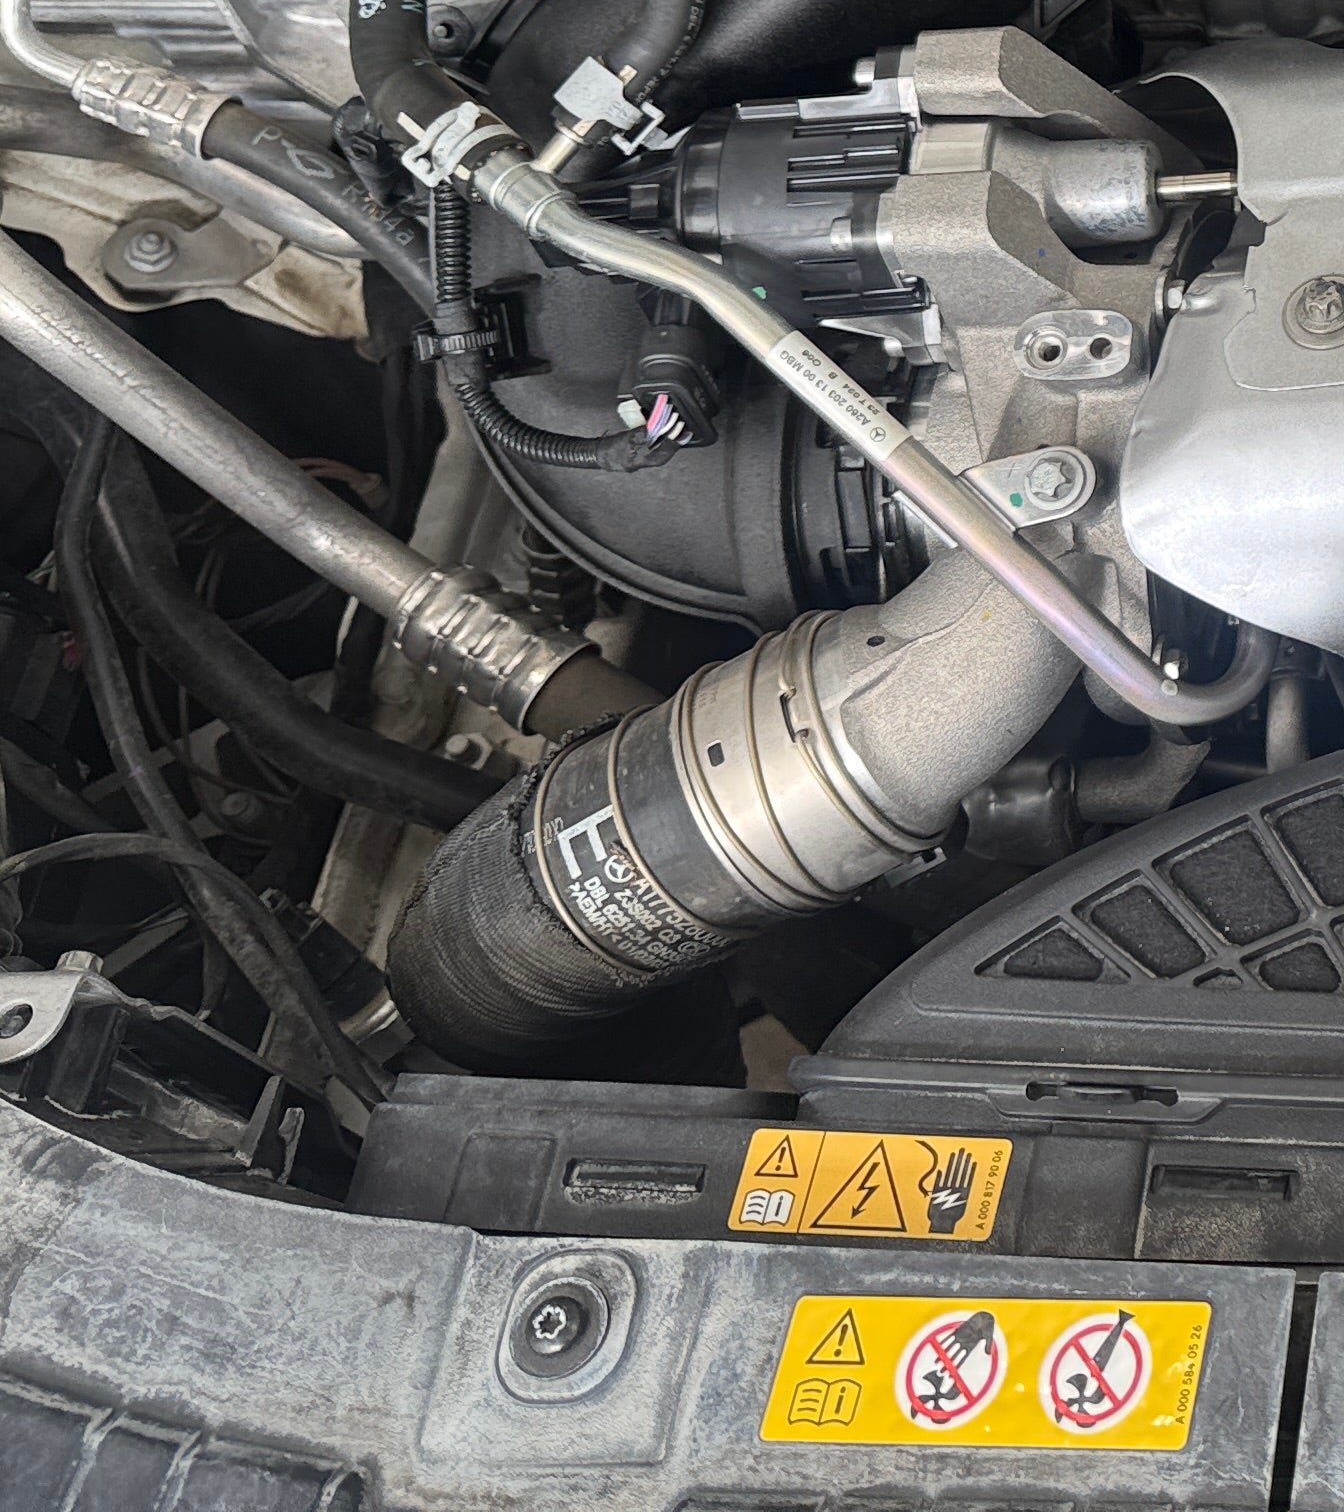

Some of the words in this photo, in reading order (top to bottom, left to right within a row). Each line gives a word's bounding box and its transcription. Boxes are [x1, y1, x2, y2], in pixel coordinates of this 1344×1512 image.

[780, 350, 805, 372] MBG
[802, 369, 817, 381] 00
[815, 379, 829, 392] 13
[828, 389, 848, 407] 203
[846, 404, 872, 426] A260
[583, 876, 611, 908] DBL
[992, 1150, 1004, 1163] 06
[988, 1165, 1000, 1178] 90
[983, 1181, 996, 1198] 817
[978, 1200, 991, 1220] 000
[1190, 1324, 1203, 1339] 26
[1187, 1343, 1199, 1359] 05
[1182, 1363, 1196, 1385] 584
[1176, 1388, 1191, 1412] 000
[1175, 1416, 1185, 1424] A
